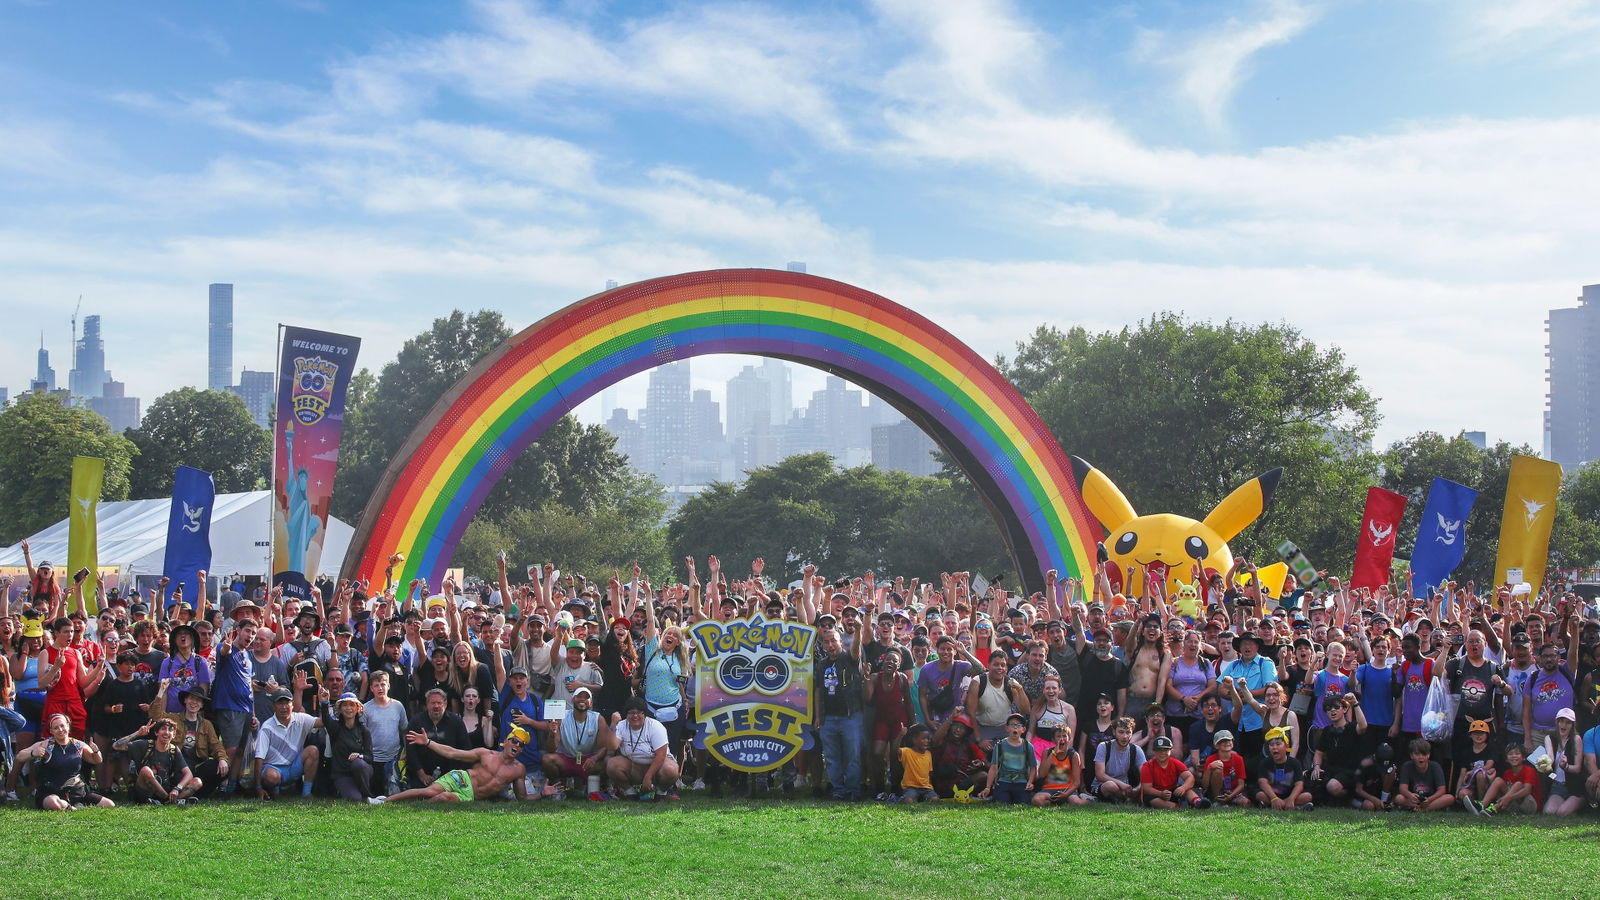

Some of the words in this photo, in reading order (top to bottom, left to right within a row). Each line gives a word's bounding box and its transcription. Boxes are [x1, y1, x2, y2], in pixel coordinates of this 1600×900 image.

[292, 339, 335, 353] WELCOME
[336, 346, 349, 356] TO
[300, 373, 326, 392] GO
[296, 398, 323, 410] FEST
[287, 583, 298, 593] JULY
[720, 654, 790, 691] GO
[711, 708, 798, 737] FEST
[722, 740, 741, 754] NEW
[742, 739, 765, 749] YORK
[766, 741, 786, 754] CITY
[738, 752, 769, 763] 2024
